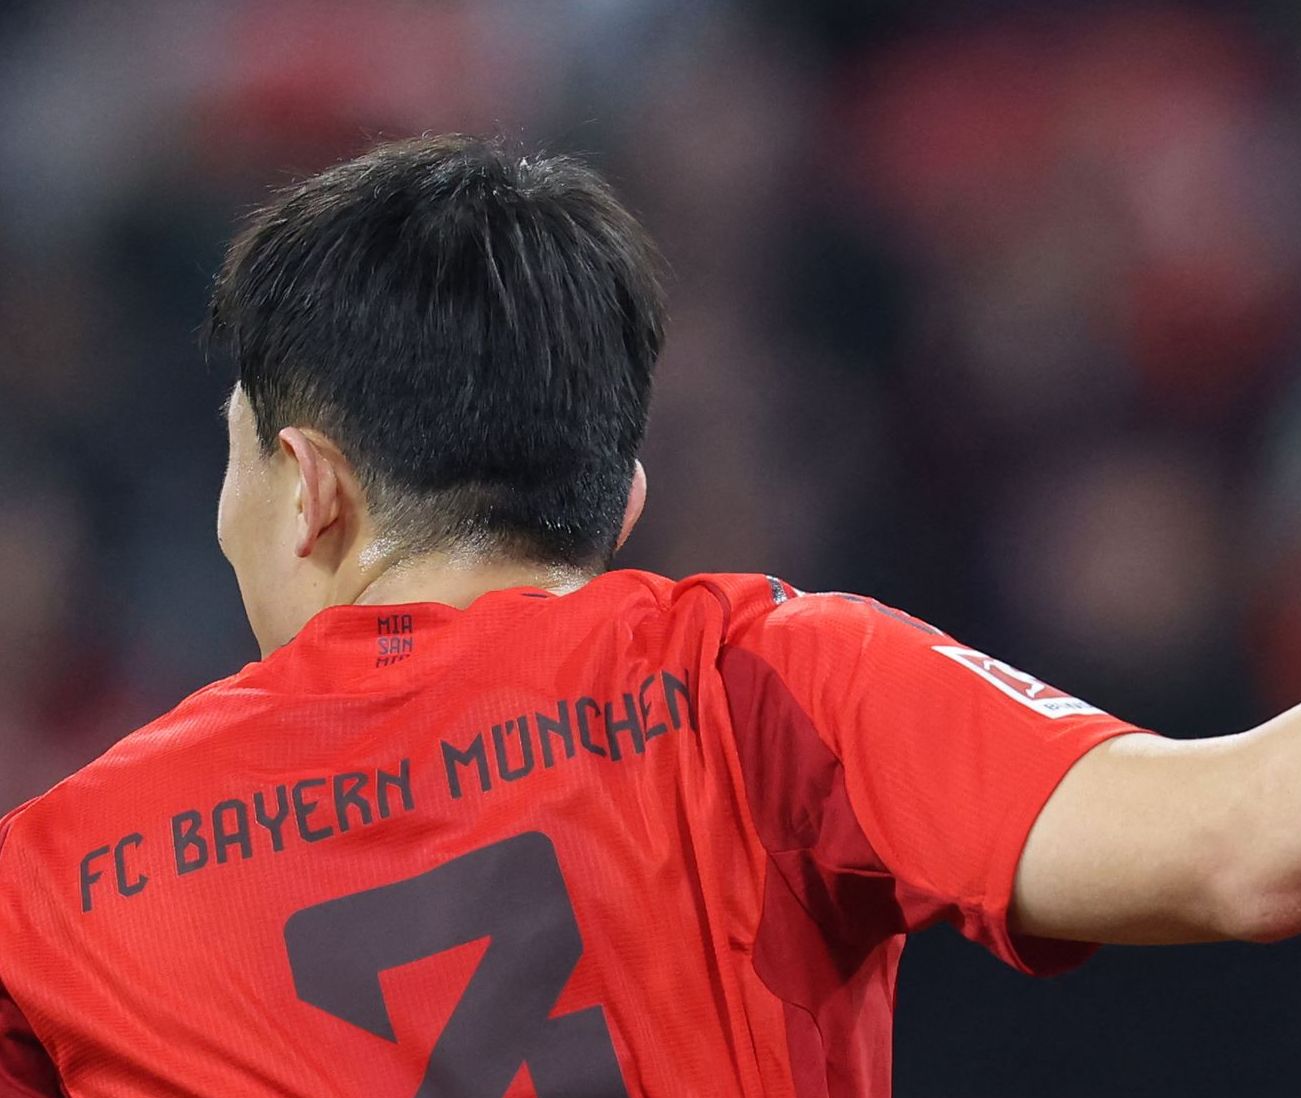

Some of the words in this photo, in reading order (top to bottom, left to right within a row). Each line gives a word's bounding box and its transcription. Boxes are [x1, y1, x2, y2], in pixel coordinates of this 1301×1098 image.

[377, 614, 413, 635] MIA
[377, 636, 413, 656] SAN
[80, 833, 149, 914] FC
[172, 759, 414, 876] BAYERN
[439, 668, 702, 800] MÜNCHEN
